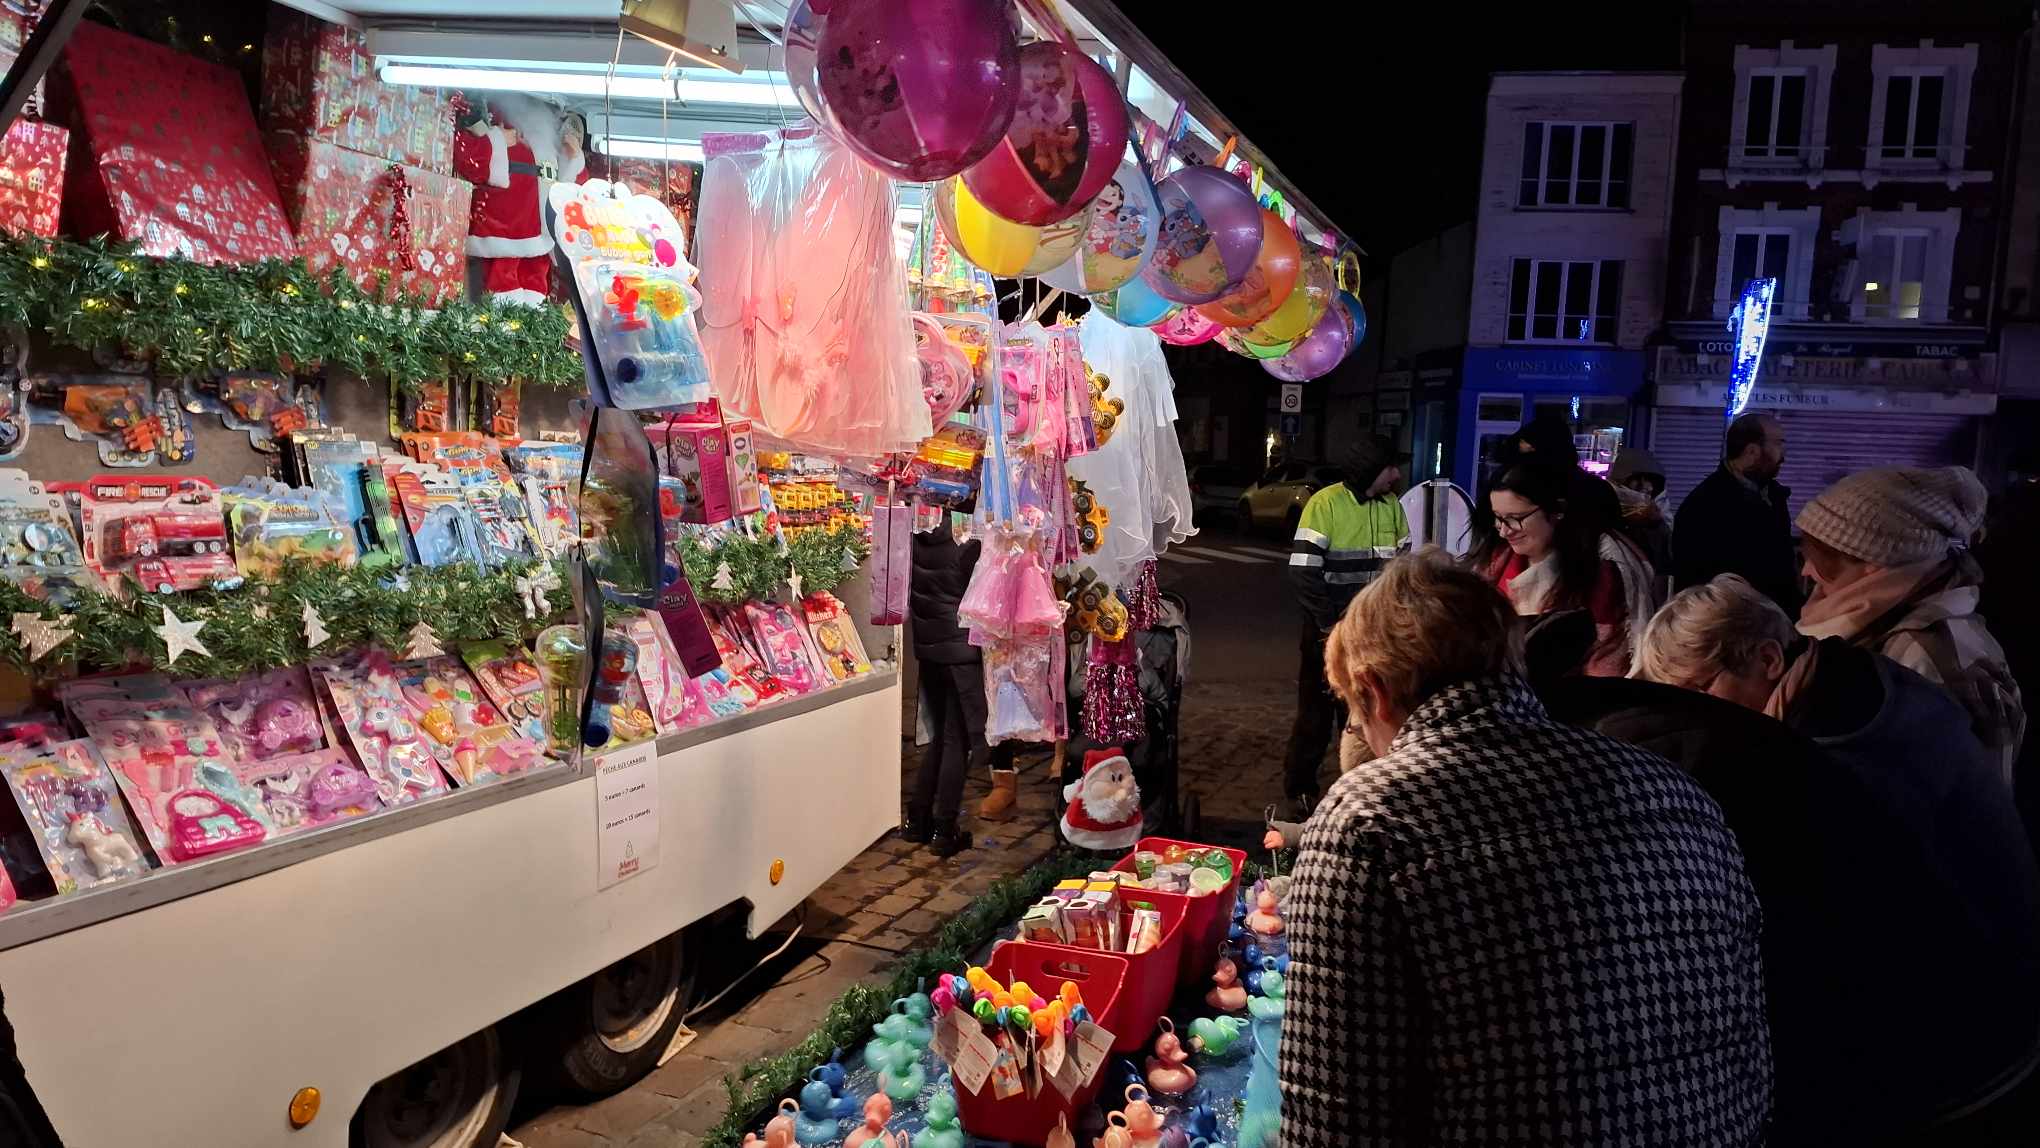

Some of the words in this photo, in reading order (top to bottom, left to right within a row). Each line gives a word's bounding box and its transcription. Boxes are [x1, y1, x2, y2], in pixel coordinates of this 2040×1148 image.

[1698, 341, 1735, 353] LOTO
[1914, 344, 1960, 357] TABAC
[97, 486, 124, 497] FIRE
[141, 486, 168, 497] RESCUE
